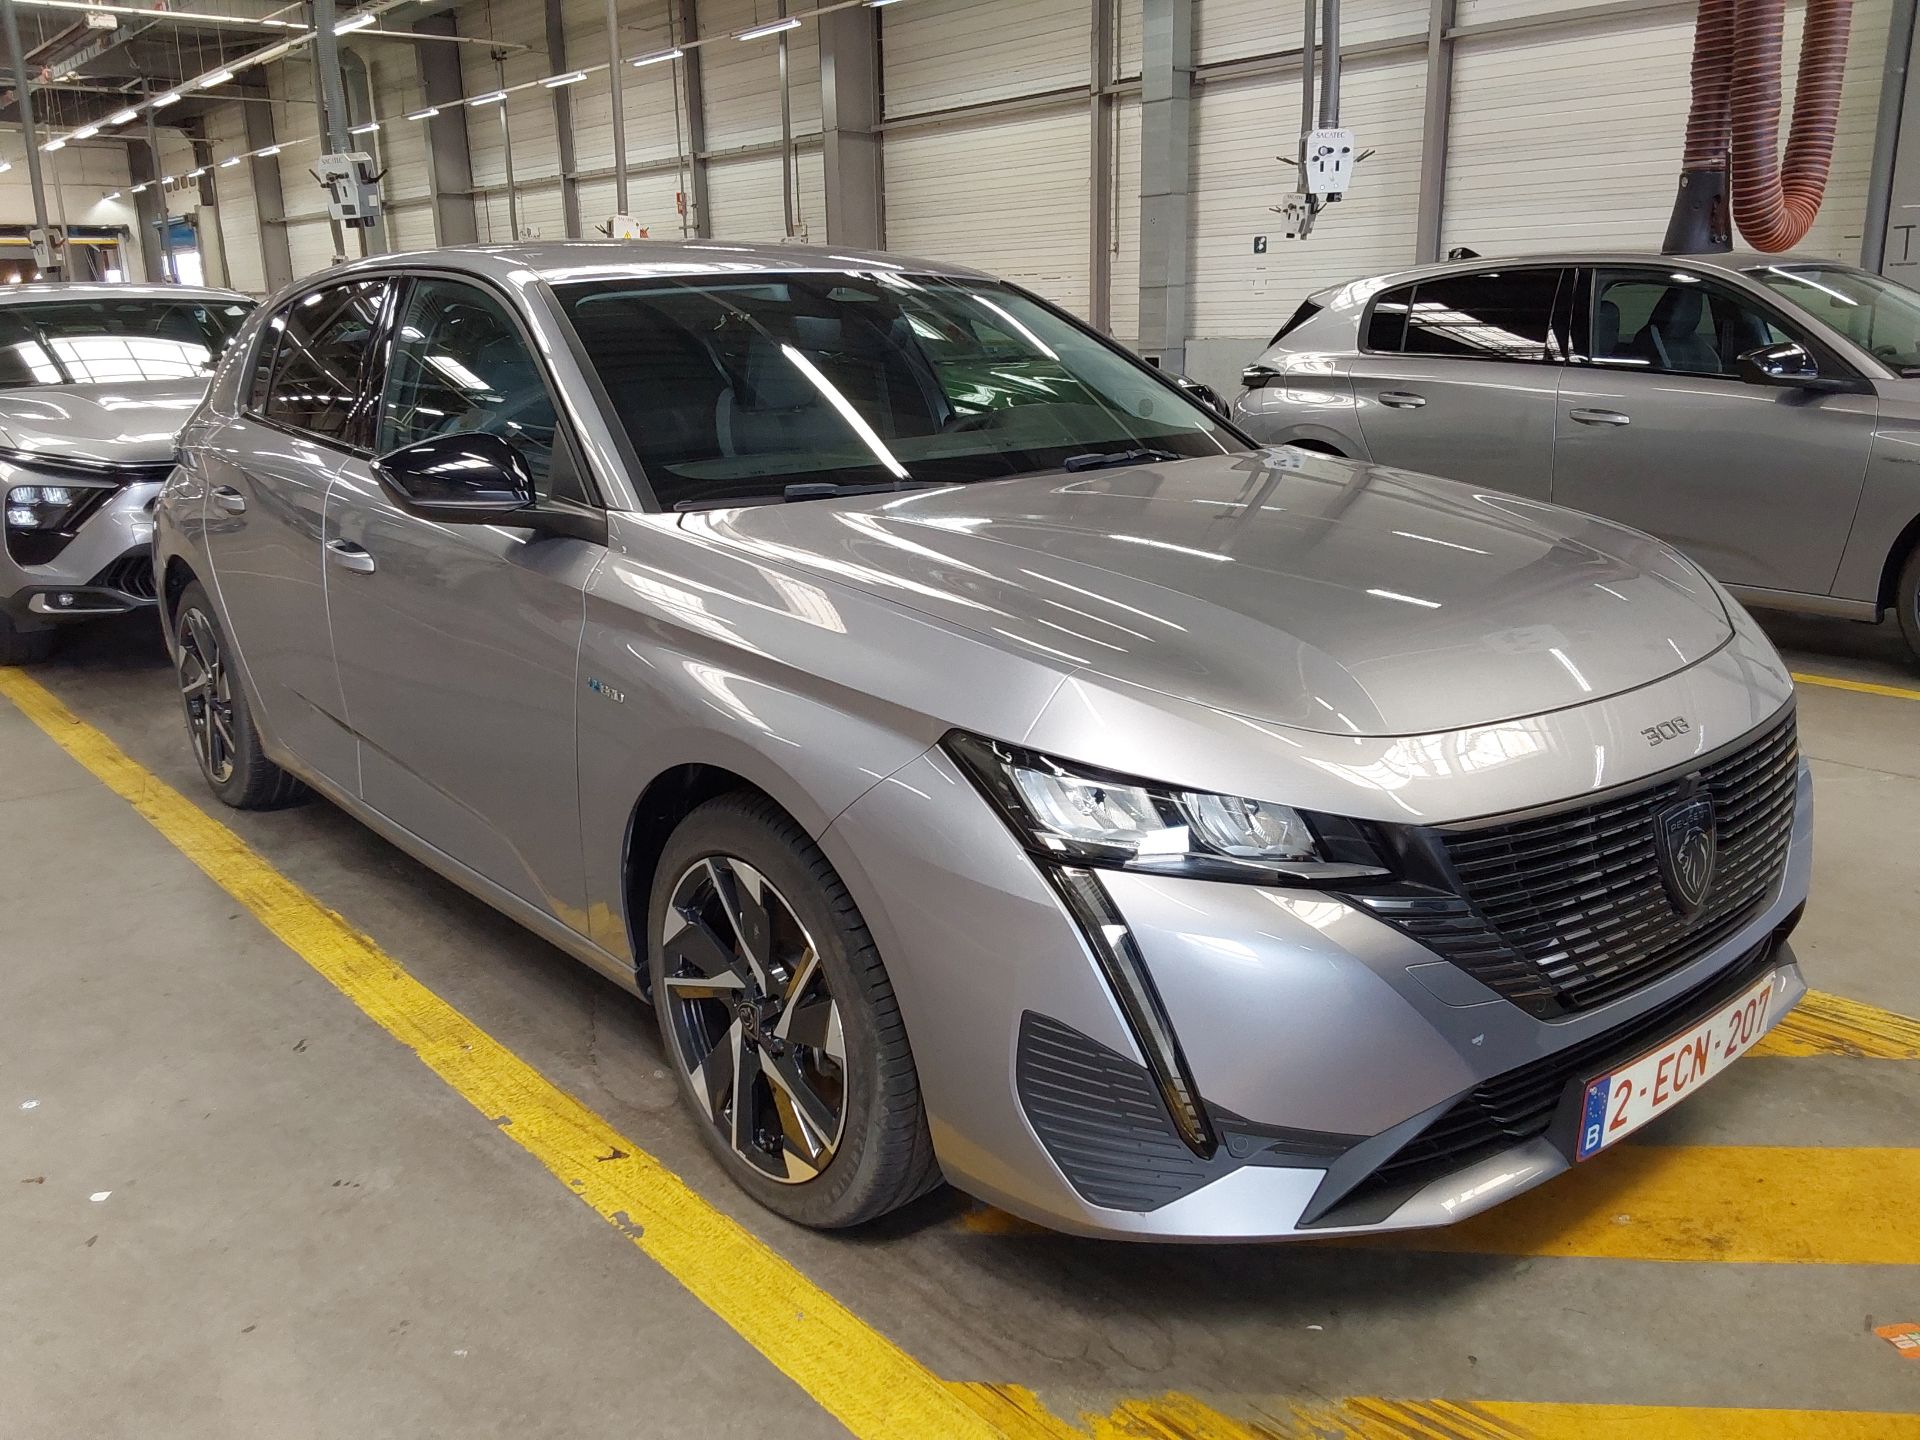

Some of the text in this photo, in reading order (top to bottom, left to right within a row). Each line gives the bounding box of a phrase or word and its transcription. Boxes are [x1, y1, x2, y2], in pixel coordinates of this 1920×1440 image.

[1316, 131, 1345, 139] SACATEC
[1640, 716, 1691, 747] 308
[1608, 984, 1772, 1132] 2-ECN-207
[1585, 1124, 1600, 1150] B
